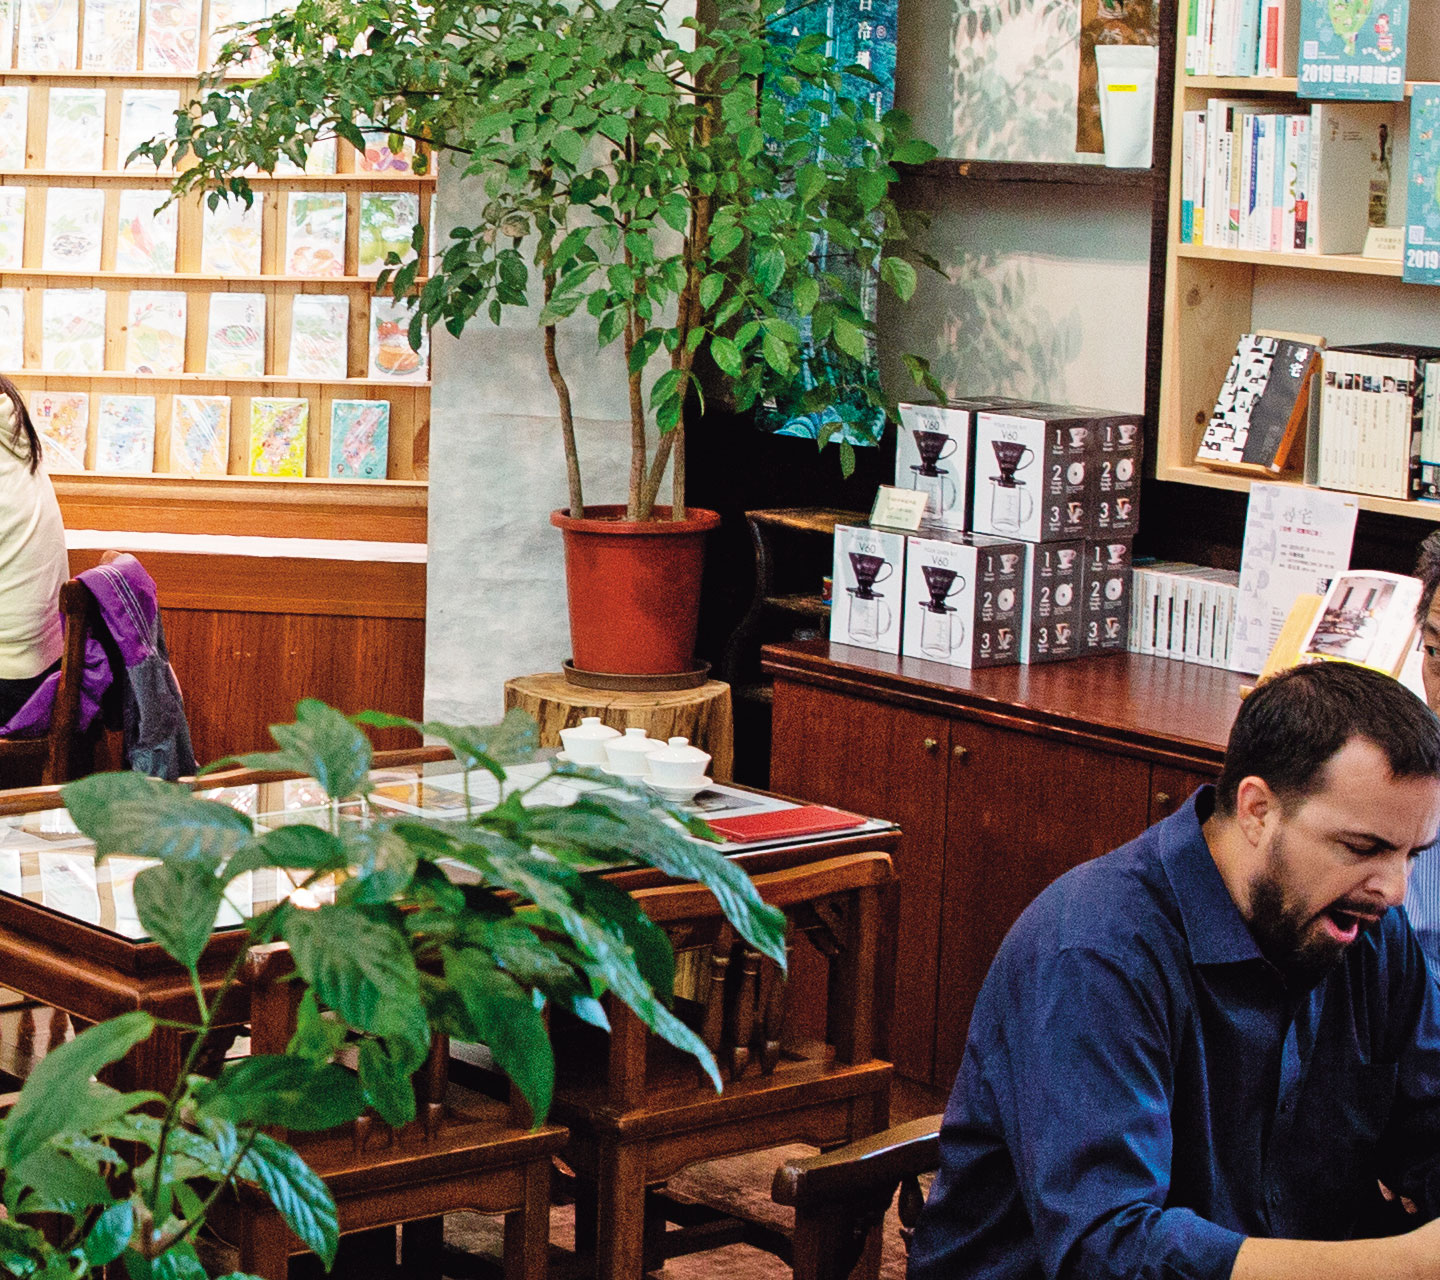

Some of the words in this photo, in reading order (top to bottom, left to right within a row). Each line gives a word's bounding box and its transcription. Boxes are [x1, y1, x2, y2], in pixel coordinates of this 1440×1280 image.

[923, 420, 940, 431] V60
[1001, 430, 1018, 441] V60
[858, 542, 877, 554] V60
[931, 555, 949, 567] V60
